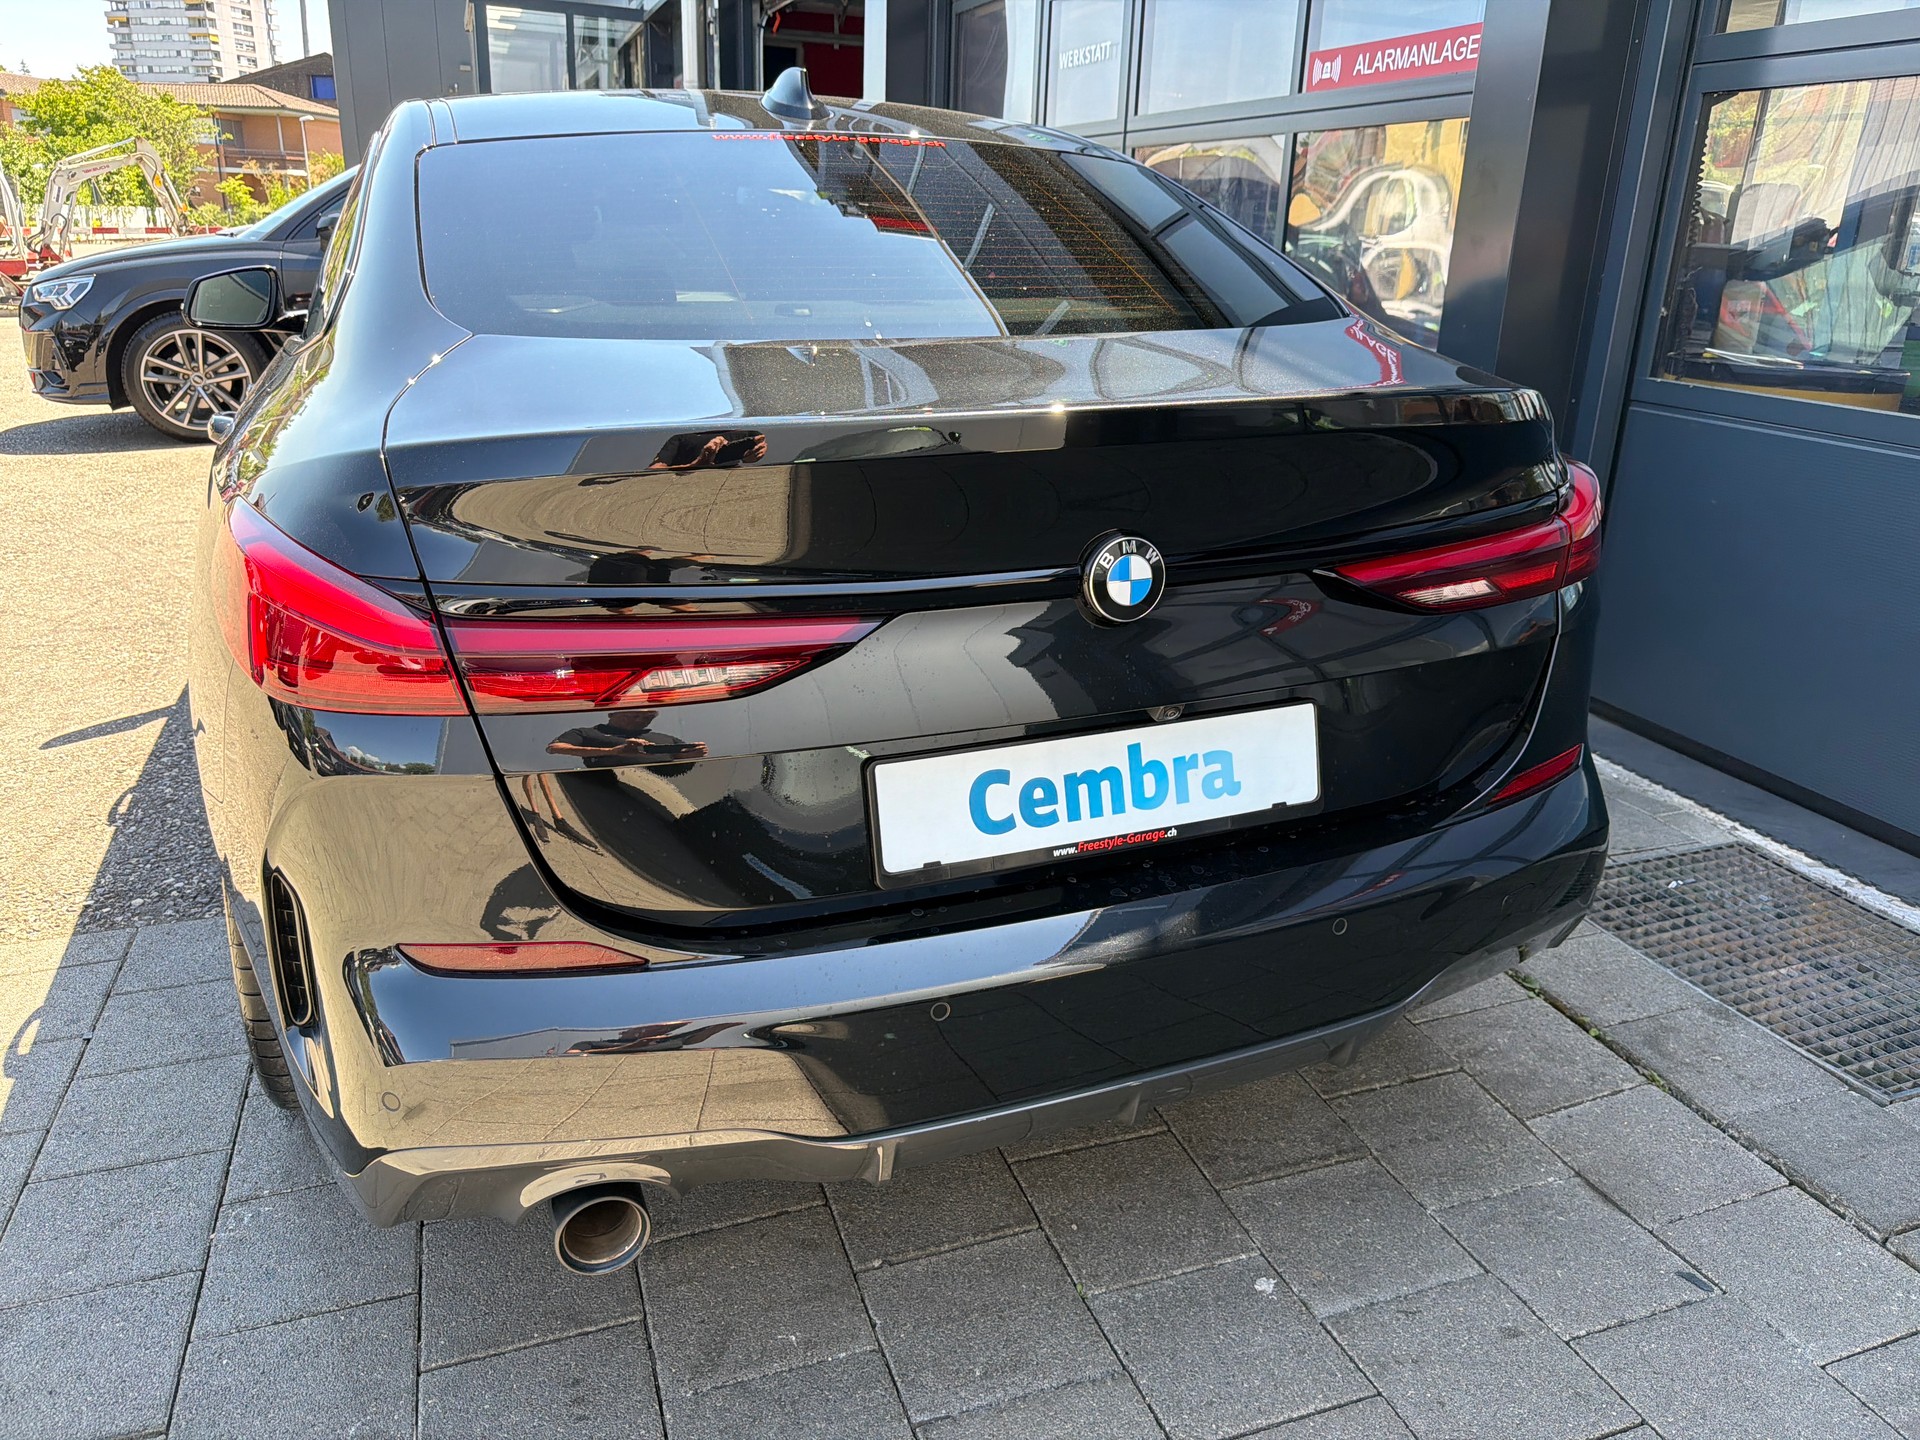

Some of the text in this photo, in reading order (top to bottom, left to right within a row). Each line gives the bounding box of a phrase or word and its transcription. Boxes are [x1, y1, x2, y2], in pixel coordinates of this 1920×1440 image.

[1059, 41, 1112, 70] WERKSTATT
[1352, 34, 1481, 76] ALARMANLAGE
[712, 132, 946, 148] www.freestyle-garage.ch
[1099, 540, 1160, 570] BMW
[969, 742, 1242, 835] Cembra
[1053, 827, 1178, 857] www.Freestyle-Garage.ch
